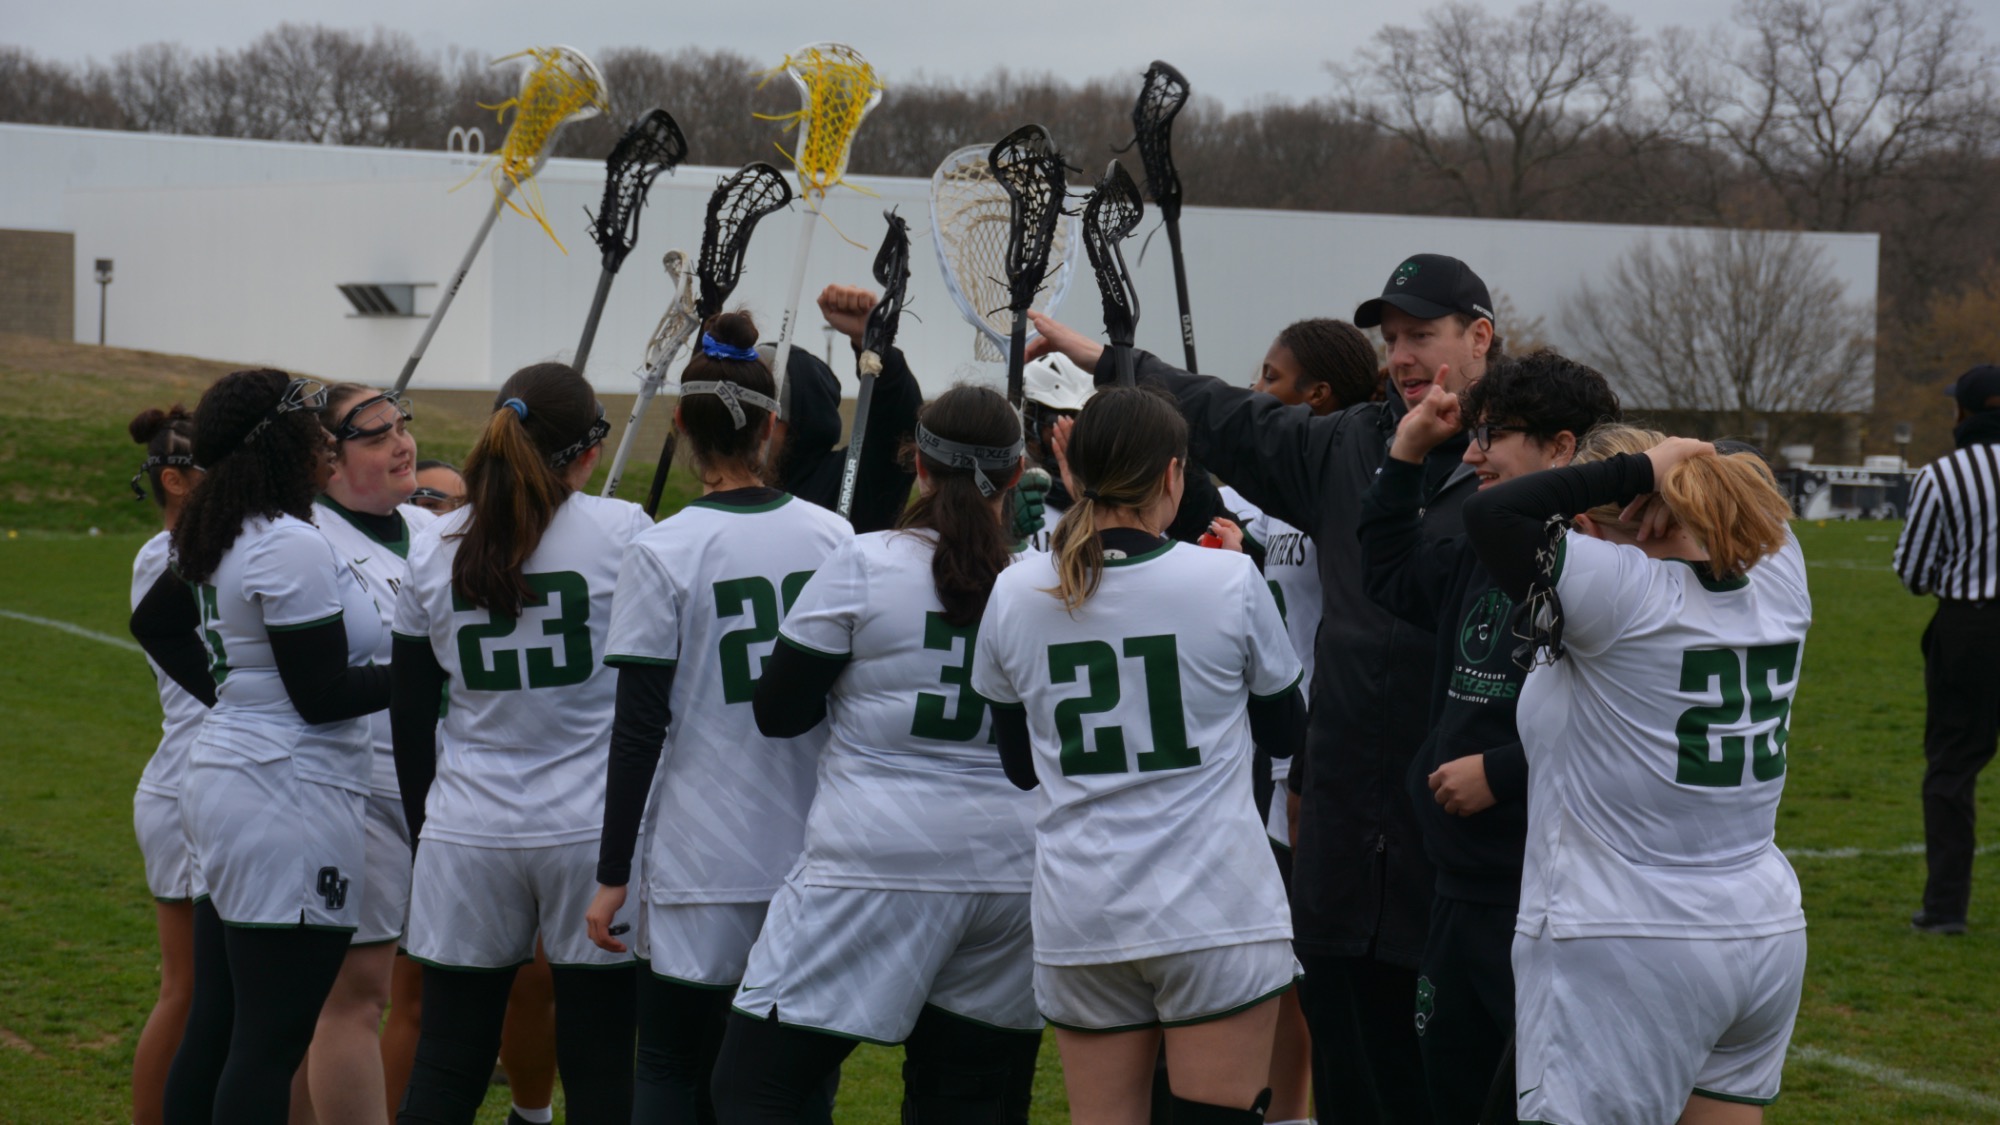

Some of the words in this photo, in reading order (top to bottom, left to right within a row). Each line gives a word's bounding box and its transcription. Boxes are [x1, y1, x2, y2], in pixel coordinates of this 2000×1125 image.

[1181, 313, 1194, 347] GAIT
[716, 385, 738, 412] STX
[607, 477, 619, 498] AIT
[839, 458, 858, 515] ARMOUR
[452, 571, 593, 691] 23
[712, 569, 817, 705] 2
[910, 611, 998, 745] 3
[1047, 634, 1201, 776] 21
[1675, 641, 1800, 787] 25
